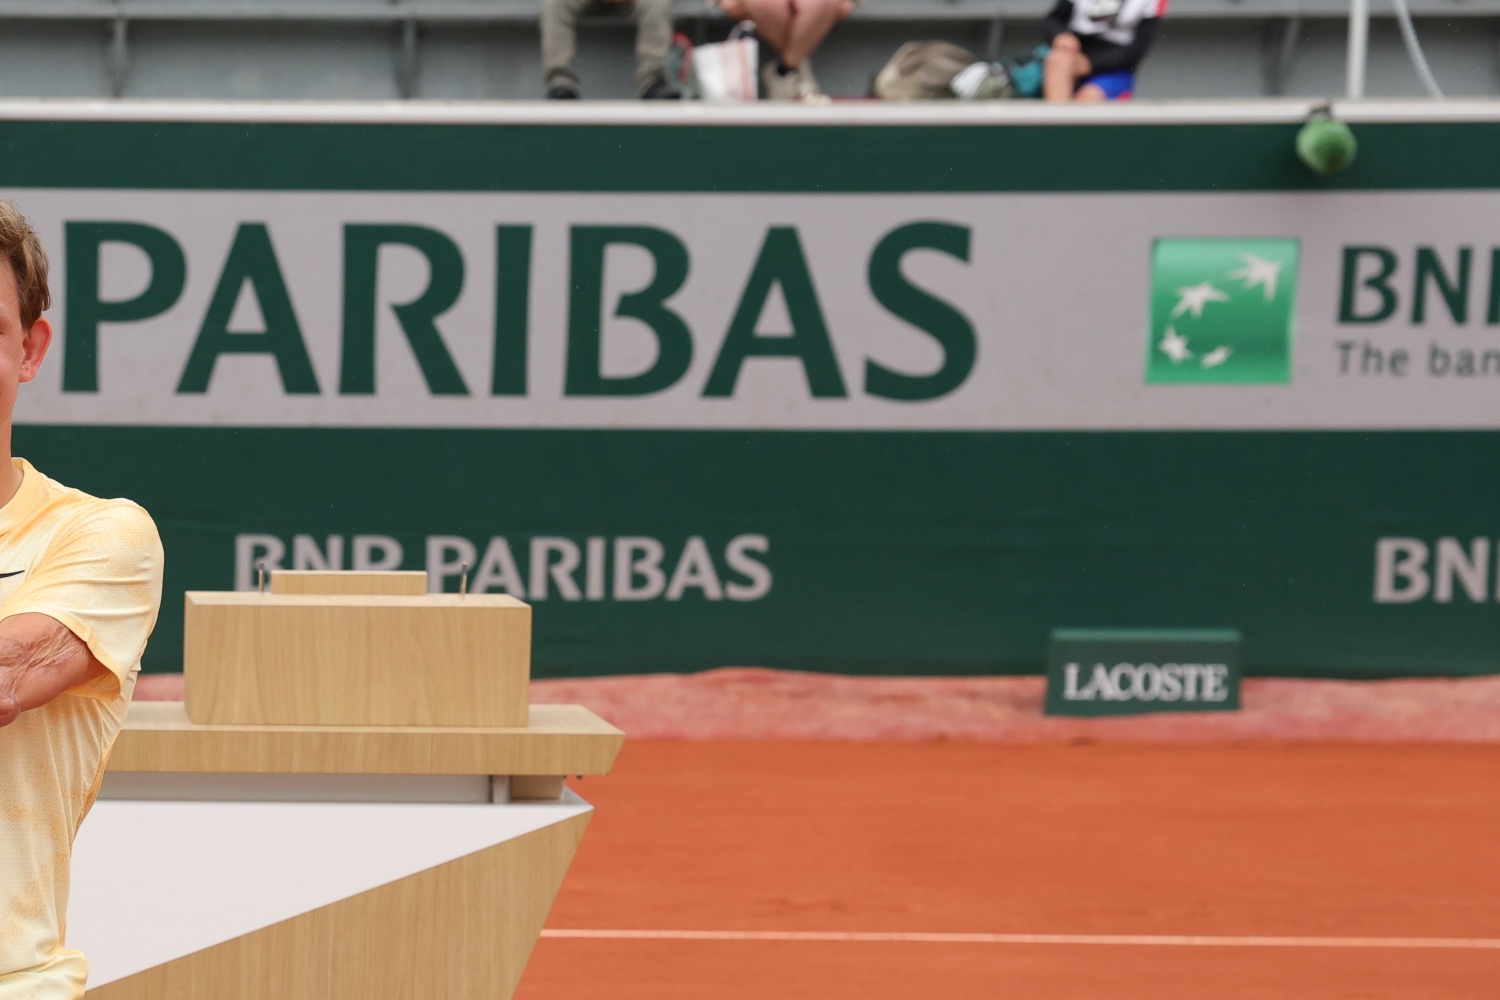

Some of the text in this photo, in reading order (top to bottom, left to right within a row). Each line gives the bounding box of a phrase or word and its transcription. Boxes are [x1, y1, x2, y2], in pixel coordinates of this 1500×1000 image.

[61, 221, 979, 404] PARIBAS
[1337, 244, 1500, 327] BN
[1335, 339, 1410, 377] The
[426, 534, 772, 601] PARIBAS
[1373, 537, 1500, 604] BN
[1063, 662, 1229, 702] LACOSTE
